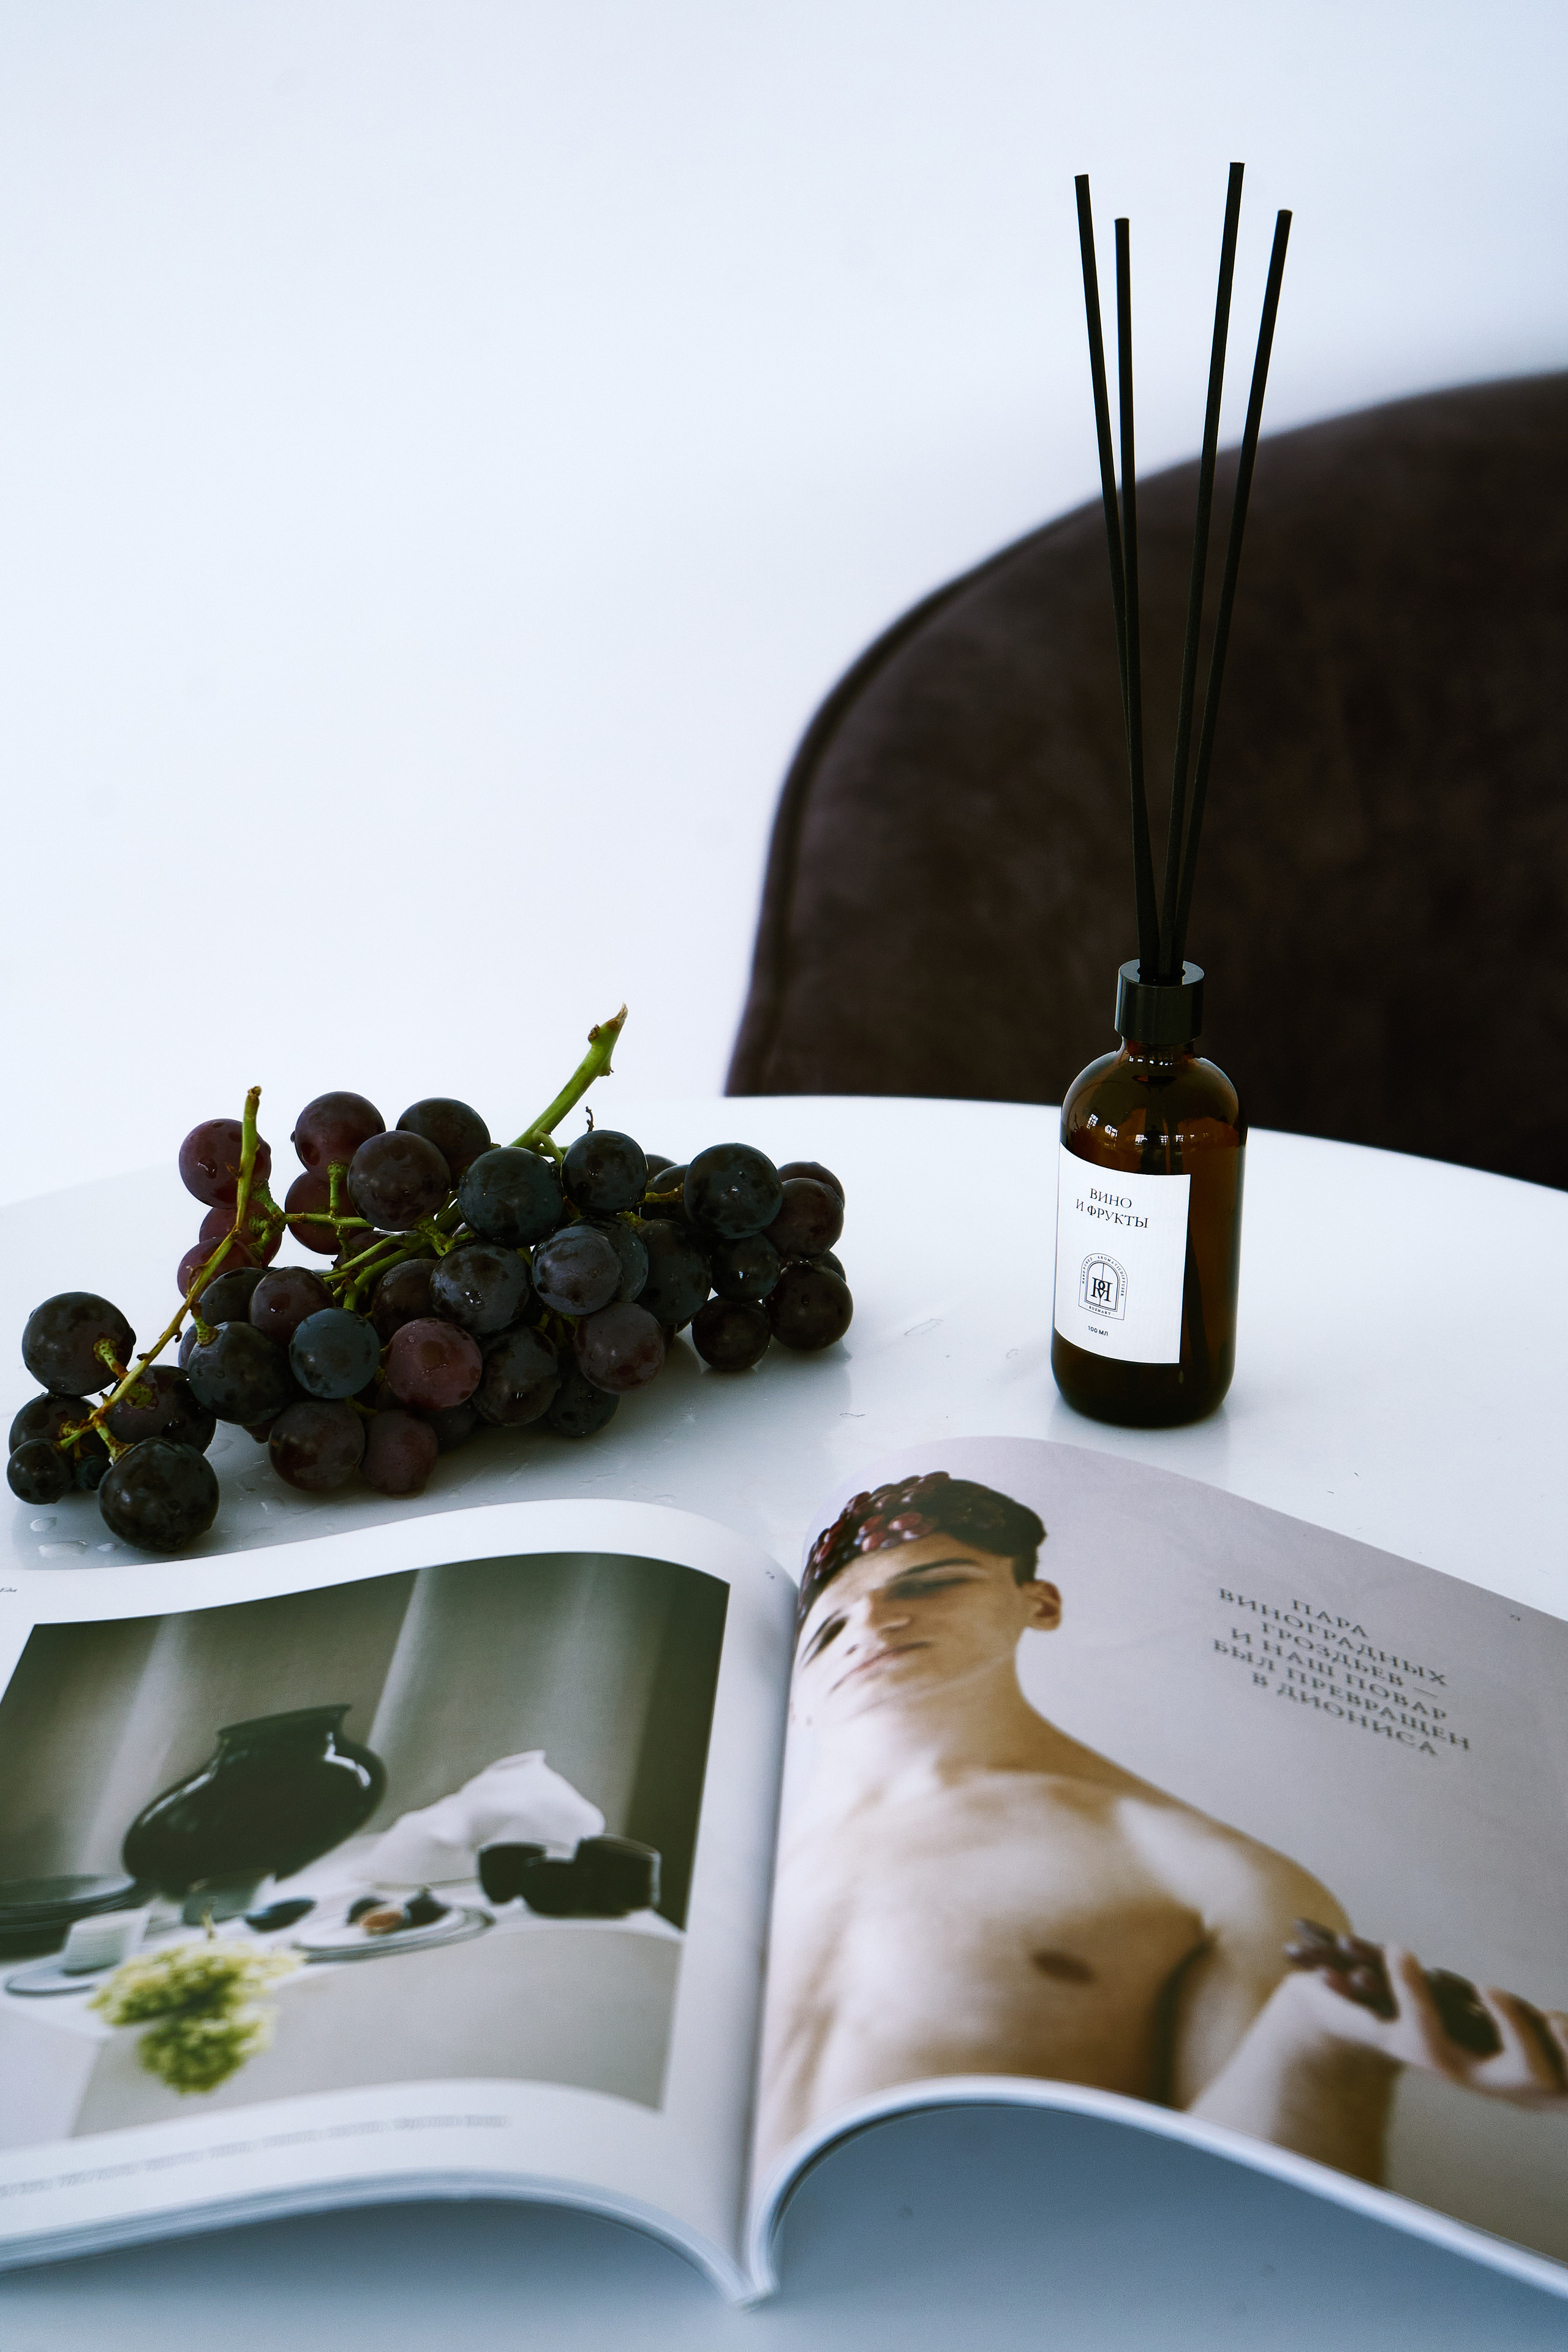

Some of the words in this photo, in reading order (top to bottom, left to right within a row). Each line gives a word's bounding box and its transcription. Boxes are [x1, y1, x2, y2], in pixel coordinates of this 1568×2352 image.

[1076, 1199, 1084, 1212] И
[1087, 1205, 1149, 1228] ФРУКТЫ
[1090, 1188, 1132, 1208] ВИНО
[1088, 1305, 1111, 1316] ROZMARY
[1219, 1587, 1447, 1686] ВИНОГРАДНЫХ
[1292, 1599, 1370, 1639] ПАРА
[1231, 1627, 1251, 1645] И
[1262, 1639, 1334, 1677] НАШ
[1346, 1672, 1447, 1720] ПОВАР
[1262, 1621, 1403, 1686] ГРОЗДЬЕВ
[1213, 1638, 1275, 1672] БЫЛ
[1287, 1667, 1469, 1751] ПРЕВРАЩЕН
[1252, 1671, 1268, 1688] В
[1276, 1682, 1438, 1756] ДИОНИСА
